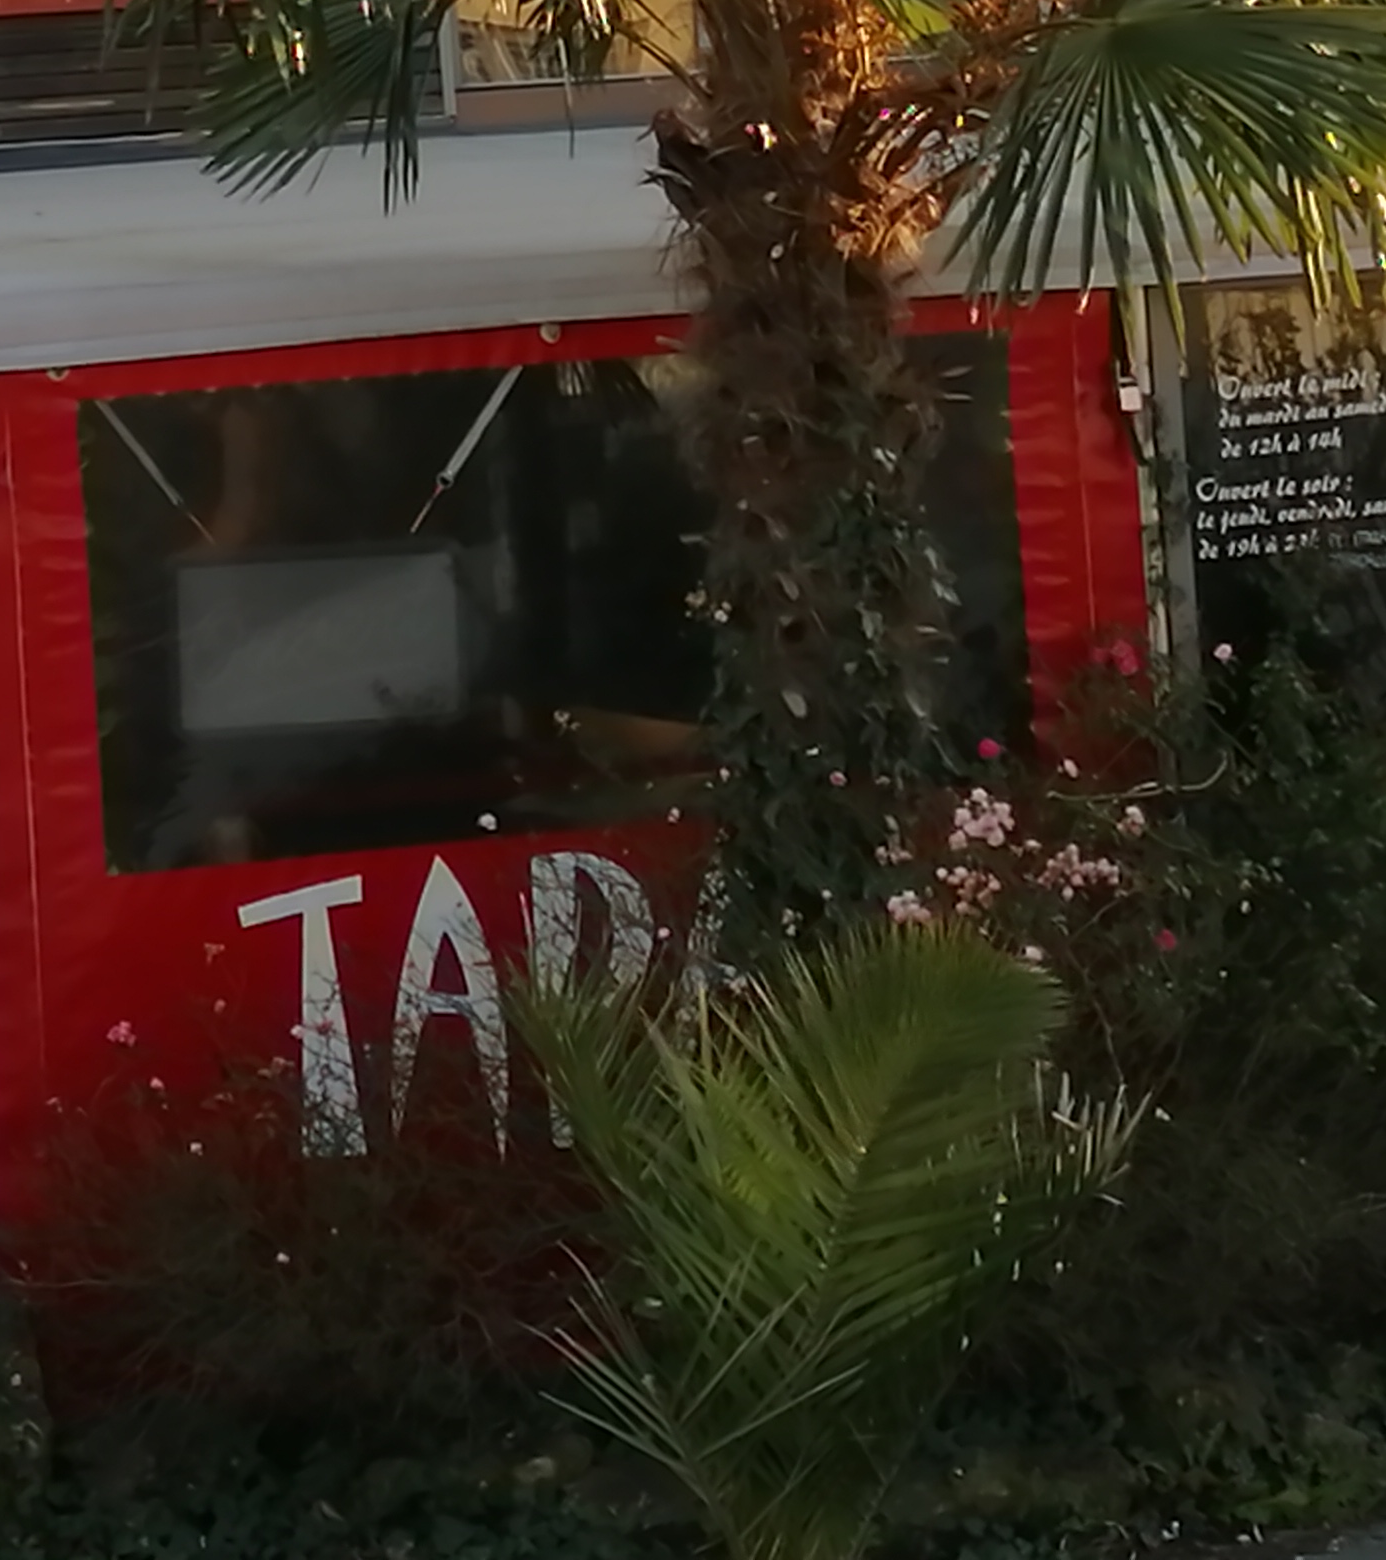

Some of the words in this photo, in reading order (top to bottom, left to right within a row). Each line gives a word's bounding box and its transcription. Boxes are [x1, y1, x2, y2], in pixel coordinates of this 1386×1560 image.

[1218, 375, 1292, 400] Ouvert
[1323, 368, 1365, 392] midi
[1219, 408, 1241, 428] du
[1246, 402, 1301, 426] mardi
[1305, 405, 1329, 420] au
[1221, 437, 1242, 459] de
[1249, 433, 1282, 456] 12h
[1196, 477, 1270, 502] Ouvert
[1276, 477, 1296, 497] le
[1302, 474, 1341, 495] soir
[1197, 512, 1214, 530] le
[1198, 538, 1219, 560] de
[1227, 533, 1260, 557] 19h
[1265, 535, 1278, 554] à
